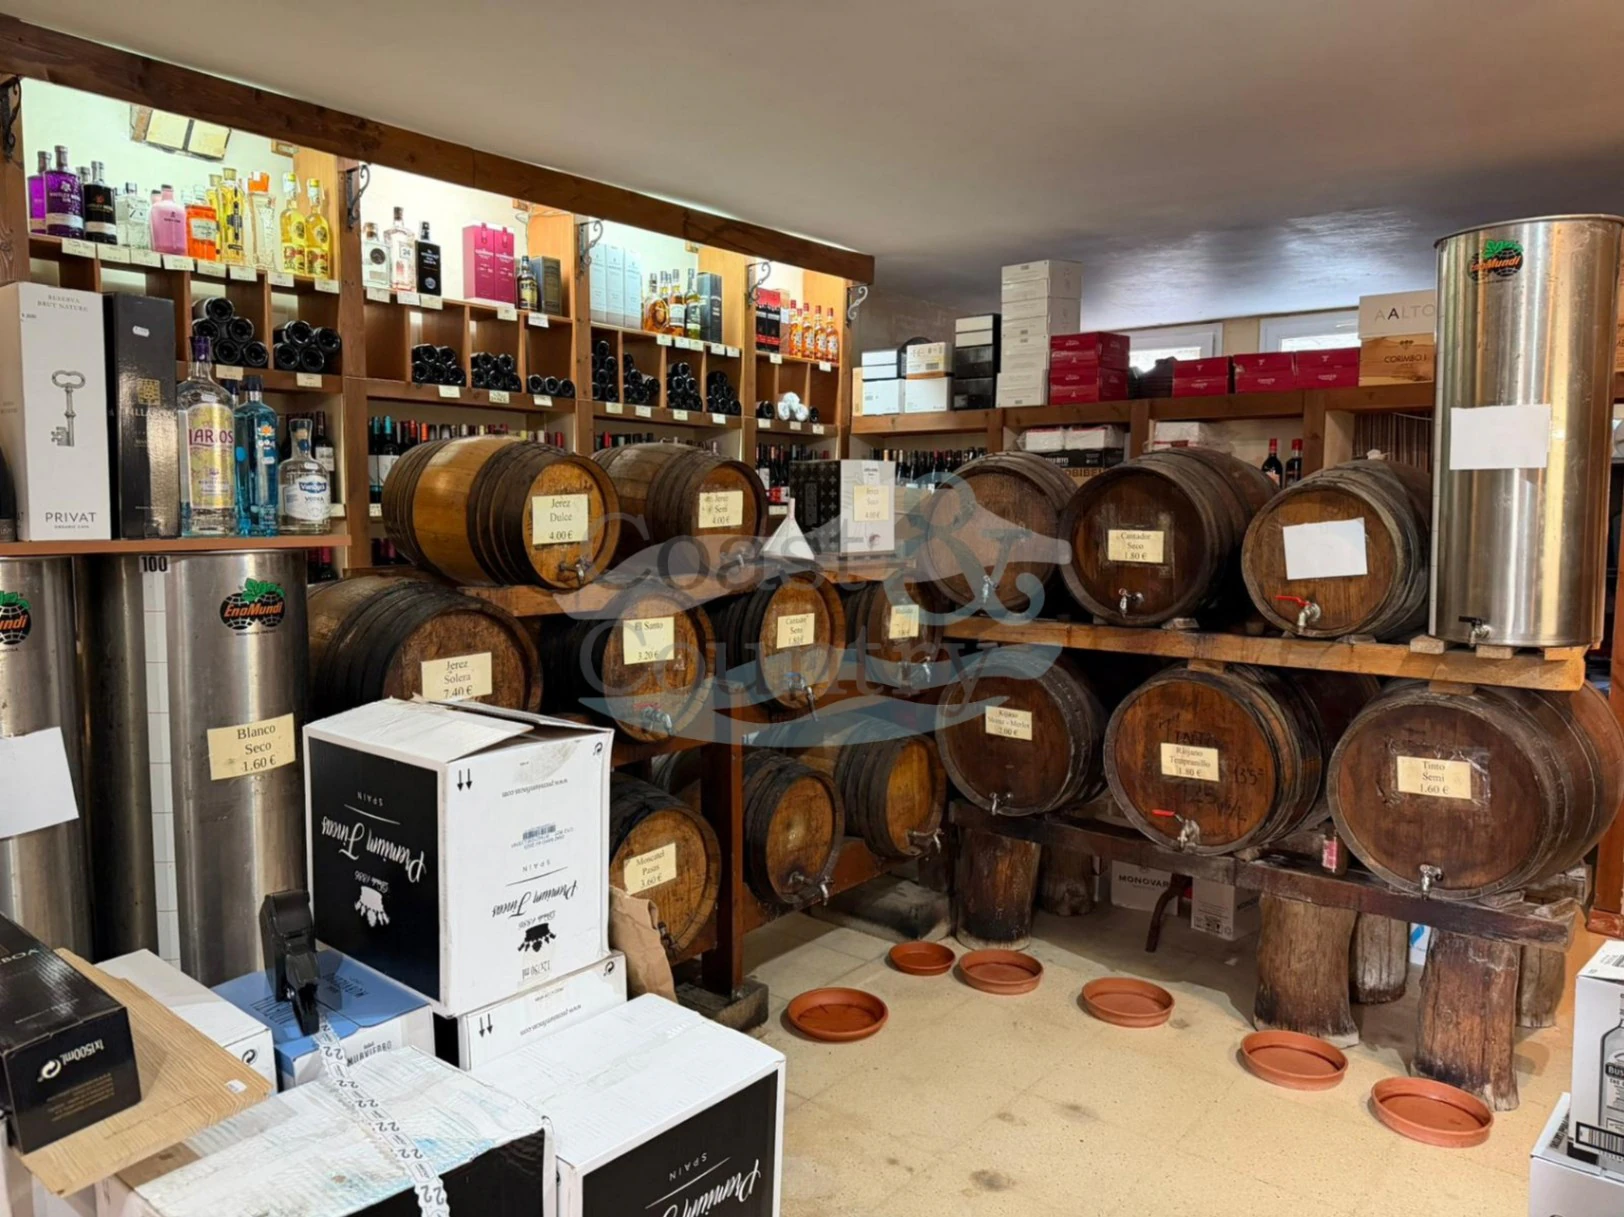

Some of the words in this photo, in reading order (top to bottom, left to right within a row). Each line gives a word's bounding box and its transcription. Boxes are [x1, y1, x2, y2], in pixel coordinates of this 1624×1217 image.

[1374, 303, 1435, 322] AALTO
[189, 428, 233, 445] LAROS
[551, 498, 571, 508] Jerez
[45, 512, 97, 522] PRIVAT
[550, 512, 573, 522] Dulce
[548, 530, 566, 541] 4.00
[567, 529, 574, 539] €
[141, 556, 168, 572] 100
[223, 601, 283, 618] EnoMundi
[644, 621, 664, 631] Santo
[446, 661, 469, 671] Jerez
[444, 673, 471, 685] Solera
[443, 686, 465, 699] 7.40
[466, 685, 473, 695] €
[237, 723, 276, 741] Blanco
[244, 741, 272, 756] Seco
[242, 757, 268, 772] 1.60
[269, 755, 277, 766] €
[1422, 760, 1446, 770] Tinto
[1422, 772, 1445, 782] Semi
[1420, 783, 1440, 794] 1.60
[1442, 785, 1449, 794] €
[357, 791, 384, 807] SPAIN
[321, 815, 365, 861] Fincas
[366, 828, 428, 884] Premium
[636, 850, 665, 866] Moscatel
[522, 859, 551, 873] SPAIN
[532, 880, 578, 905] Premium
[491, 890, 532, 919] Fincas
[0, 948, 39, 965] BOA
[668, 1152, 708, 1182] SPAIN
